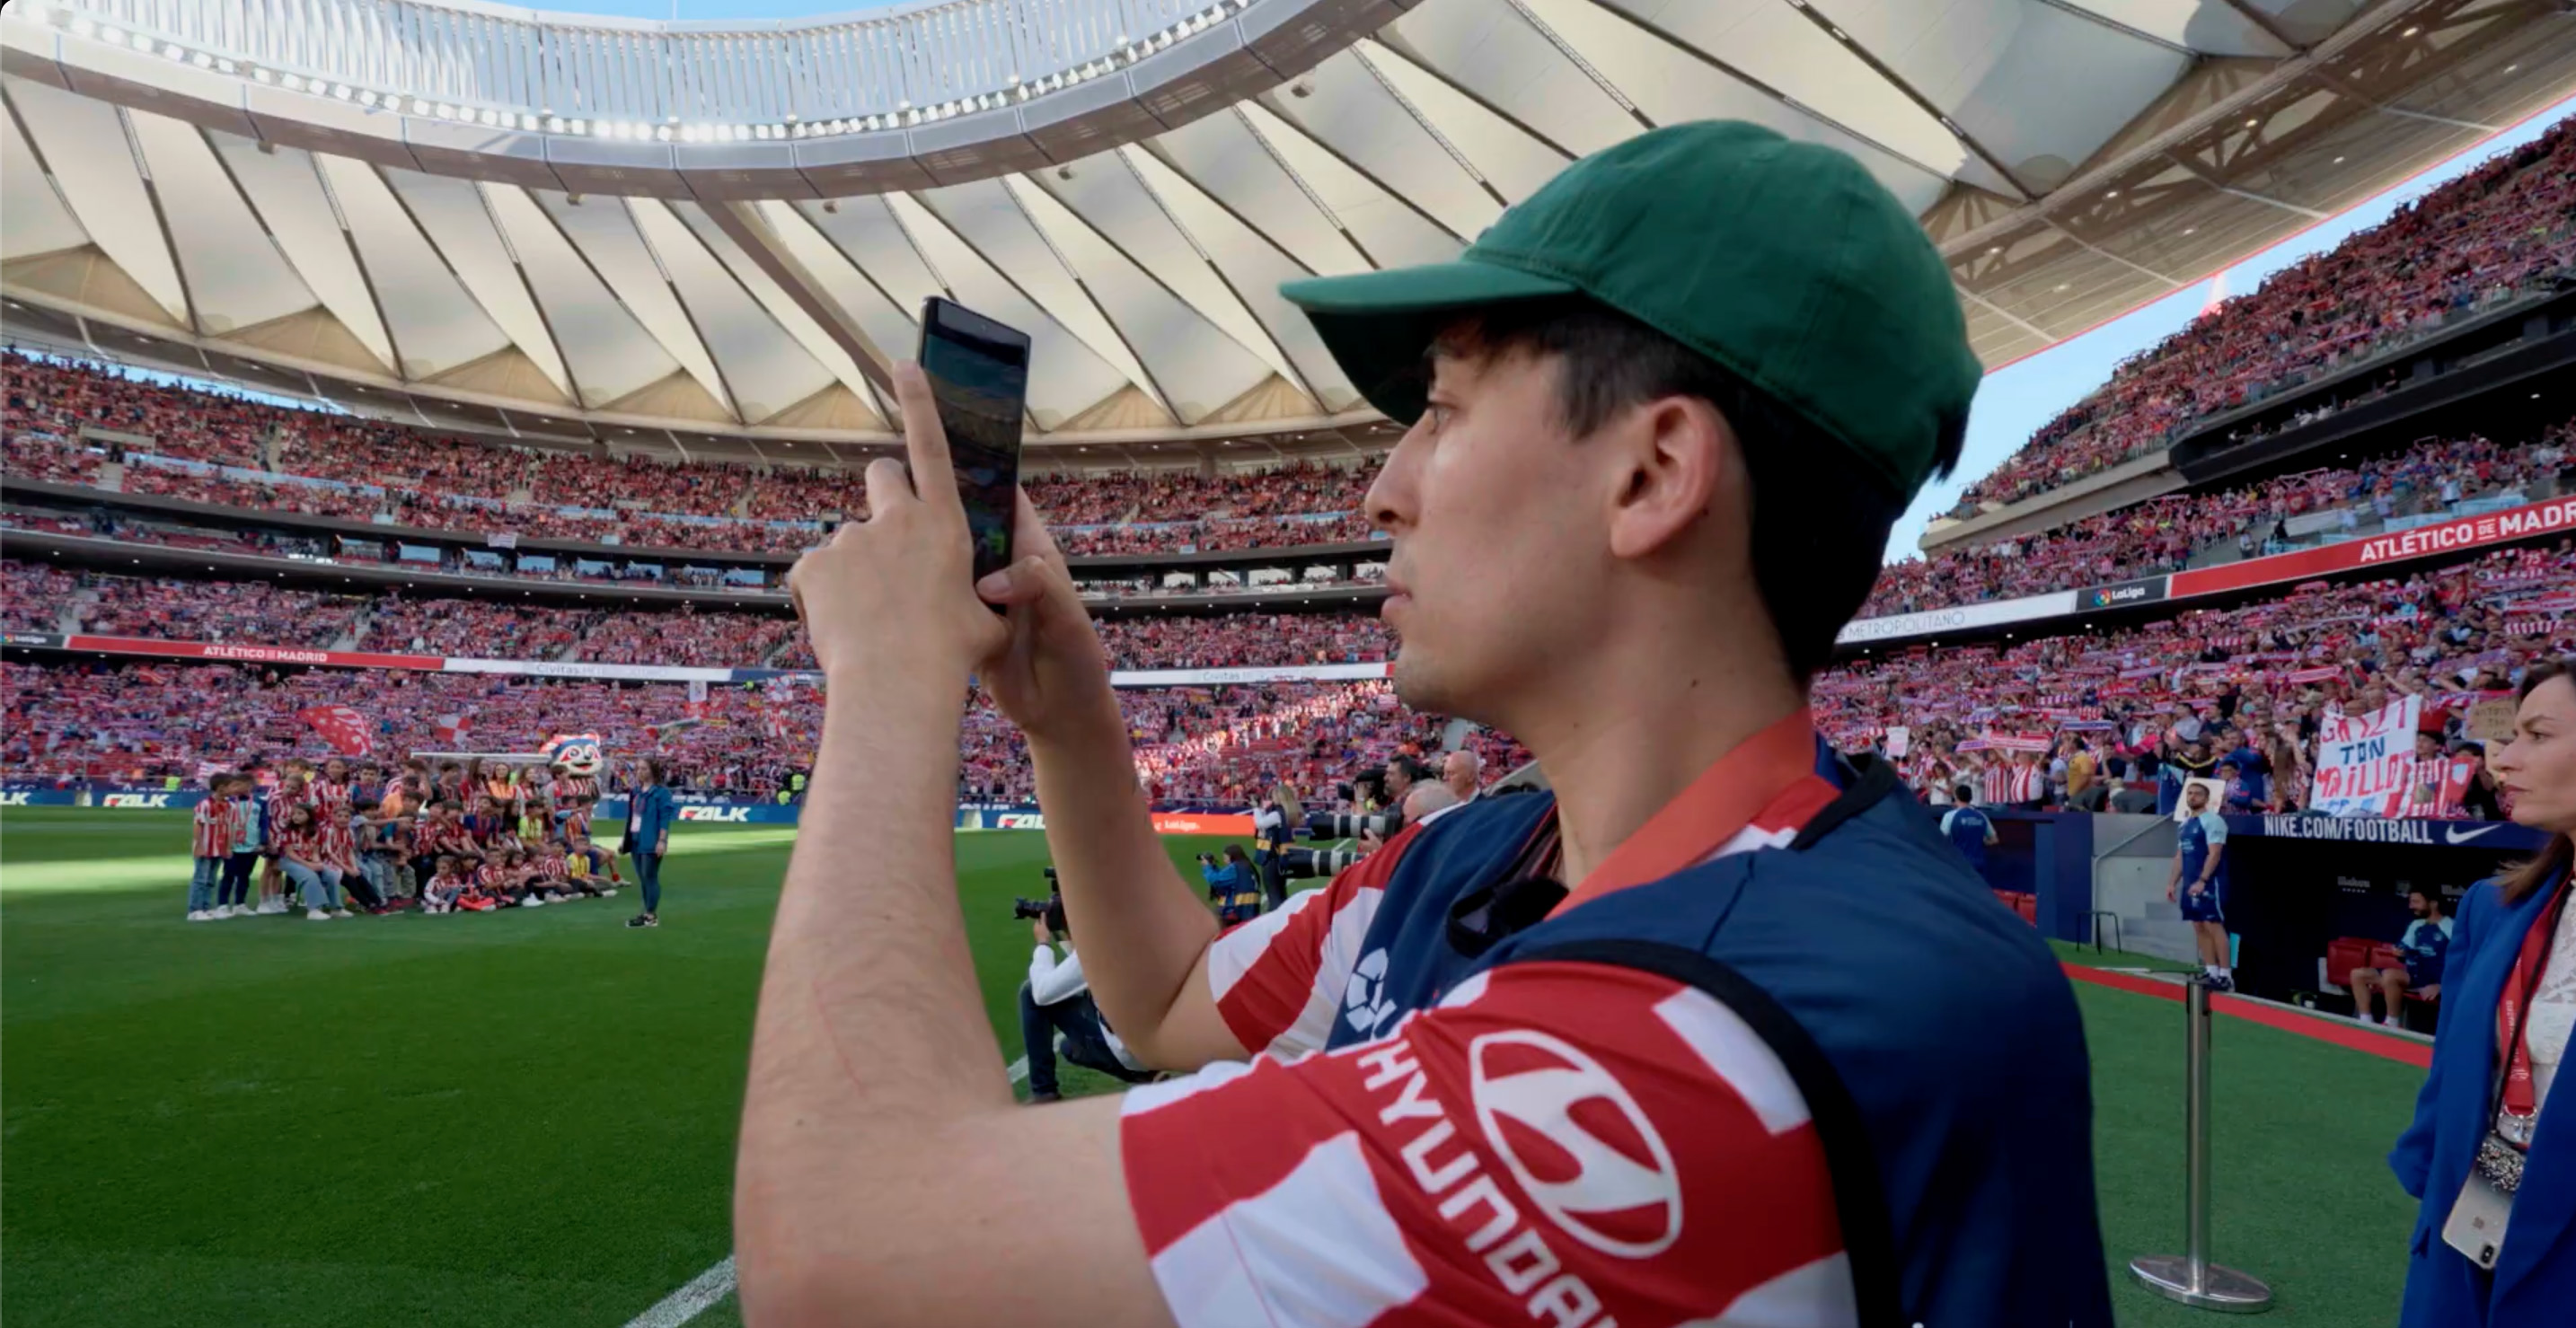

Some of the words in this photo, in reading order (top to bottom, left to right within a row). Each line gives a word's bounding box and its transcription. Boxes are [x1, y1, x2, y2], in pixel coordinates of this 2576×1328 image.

[2360, 523, 2473, 563] ATLÉTICO
[2477, 523, 2496, 536] DE
[2500, 500, 2576, 536] MADR
[1848, 611, 1965, 639] METROPOLITANO
[204, 646, 265, 660] ATLÉTICO
[278, 651, 328, 663] MADRID
[2340, 735, 2386, 765] TON
[0, 792, 31, 806] LK
[997, 814, 1045, 830] FAL
[2264, 815, 2434, 844] NIKE.COM/FOOTBALL
